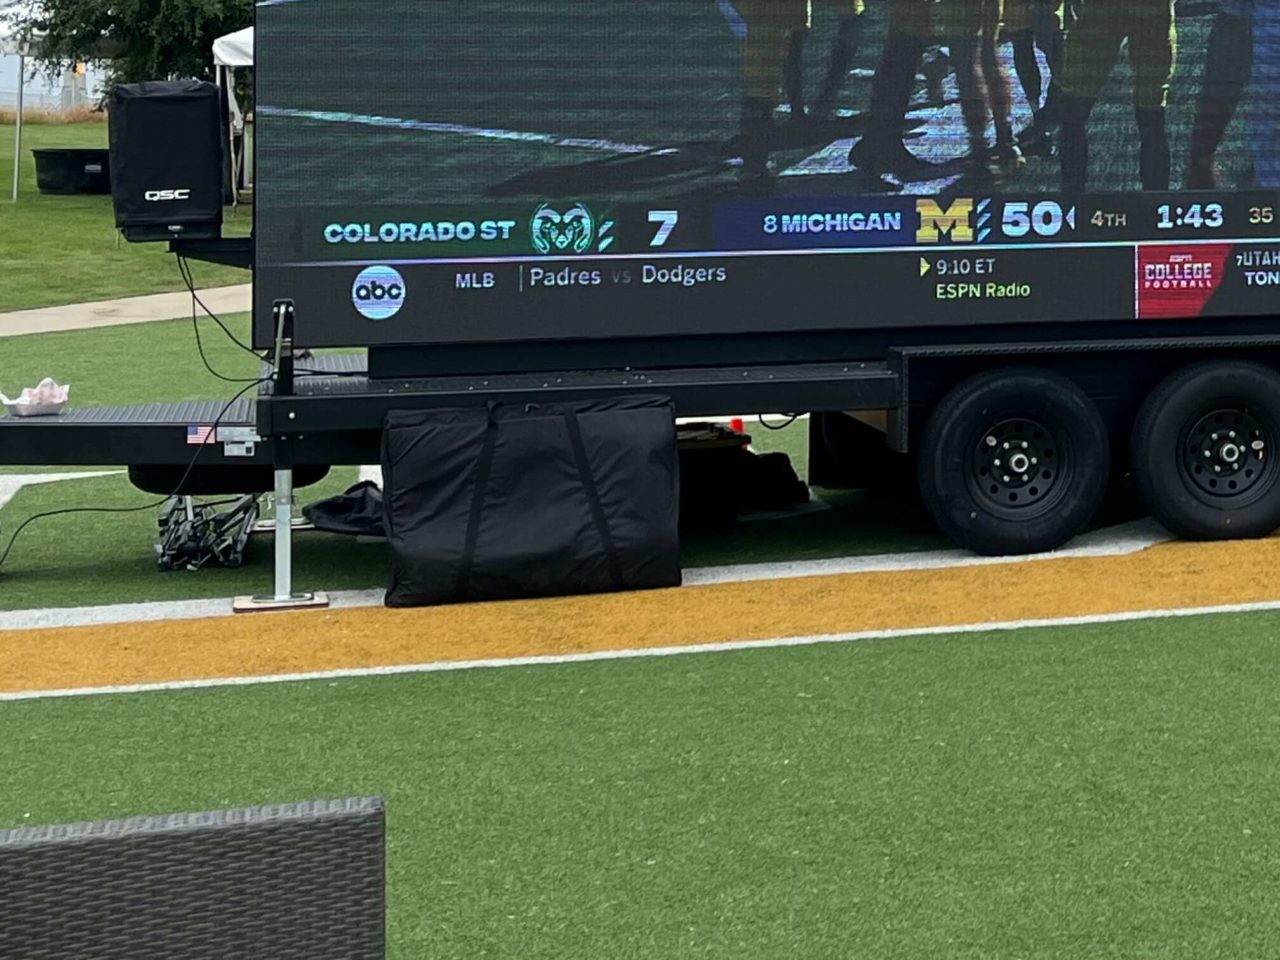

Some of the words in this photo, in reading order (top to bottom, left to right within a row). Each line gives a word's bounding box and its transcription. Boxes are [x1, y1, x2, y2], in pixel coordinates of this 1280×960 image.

[144, 189, 190, 201] QSC
[763, 215, 778, 233] 8
[782, 212, 902, 233] MICHIGAN
[1001, 200, 1062, 237] 50
[1090, 210, 1127, 227] 4TH
[1157, 203, 1223, 229] 1:43
[1249, 207, 1274, 224] 35
[323, 220, 476, 243] COLORADO
[480, 220, 516, 239] ST
[647, 210, 679, 246] 7
[936, 259, 970, 275] 9:10
[975, 258, 996, 273] ET
[1145, 263, 1212, 279] COLLEGE
[455, 273, 495, 288] MLB
[530, 268, 601, 286] Padres
[611, 270, 632, 284] vs
[642, 265, 726, 286] Dodgers
[1145, 280, 1212, 288] FOOTBALL
[356, 281, 402, 300] abc
[936, 283, 981, 299] ESPN
[986, 283, 1030, 298] Radio
